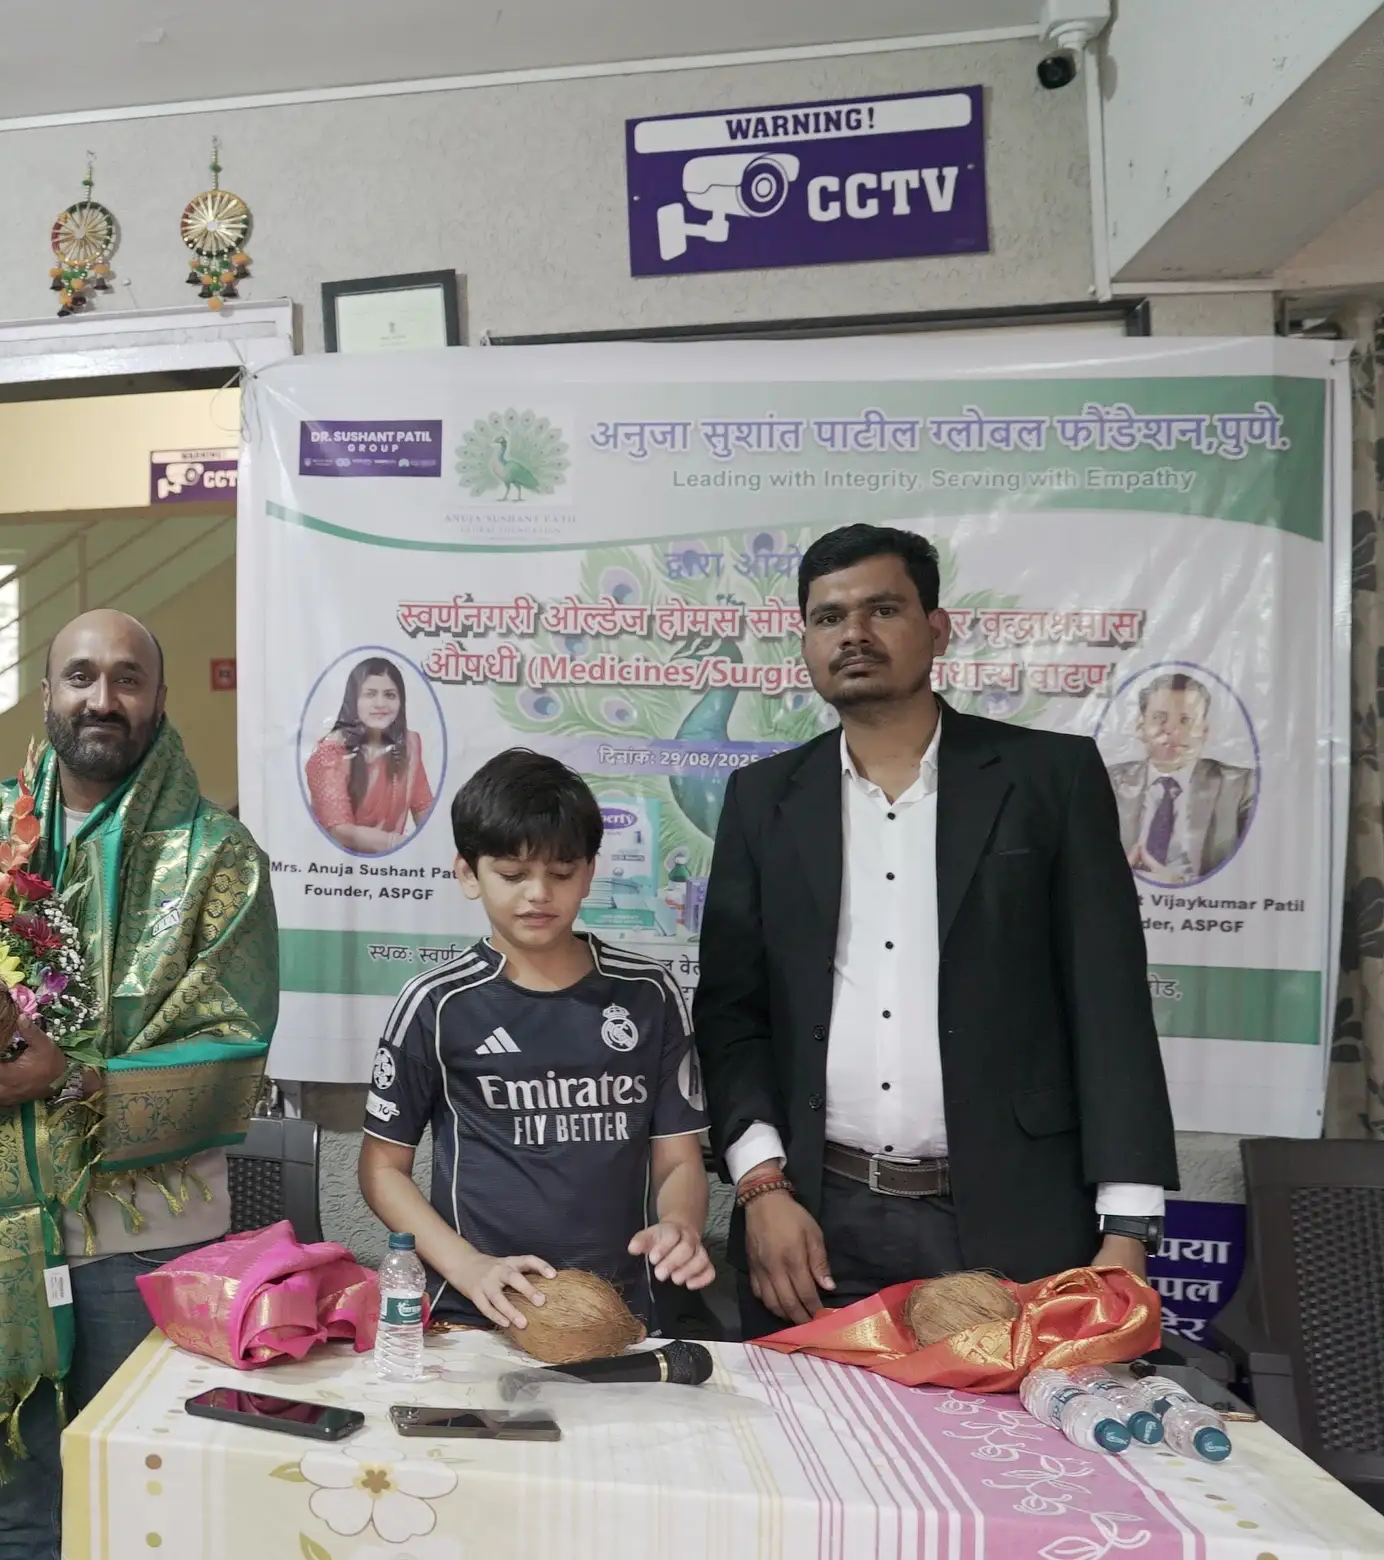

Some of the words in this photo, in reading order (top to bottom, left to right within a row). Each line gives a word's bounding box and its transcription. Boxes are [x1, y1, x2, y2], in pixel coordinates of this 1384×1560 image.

[725, 106, 875, 141] WARNING!
[807, 166, 958, 222] CCTV
[311, 431, 331, 442] DR.
[334, 431, 394, 442] SUSHANT
[396, 431, 432, 442] PATIL
[590, 420, 692, 458] अनुजा
[701, 413, 804, 458] सुशांत
[813, 409, 920, 449] पाटील
[930, 408, 1046, 449] ग्लोबल
[347, 443, 399, 453] GROUP
[203, 469, 238, 488] CCT
[672, 470, 761, 491] Leading
[769, 470, 816, 487] with
[931, 470, 1020, 491] Serving
[1028, 470, 1077, 487] with
[1087, 470, 1195, 491] Empathy
[399, 595, 536, 634] स्वर्णनगरी
[542, 597, 646, 634] ओल्डेज
[656, 597, 739, 634] होमस
[748, 597, 803, 634] सोश
[425, 641, 517, 681] औषधी
[528, 655, 810, 692] (Medicines/Surgic
[598, 745, 655, 765] दिनांक:
[271, 861, 301, 873] Mrs.
[307, 862, 353, 877] Anuja
[359, 864, 425, 878] Sushant
[431, 867, 458, 879] Pat
[304, 884, 372, 900] Founder,
[378, 887, 434, 900] ASPGF
[1151, 894, 1257, 911] Vijaykumar
[1263, 898, 1305, 912] Patil
[1141, 918, 1174, 933] der,
[1181, 919, 1244, 933] ASPGF
[418, 943, 463, 963] स्वर्ण
[477, 1070, 648, 1111] Emirates
[514, 1113, 549, 1145] FLY
[556, 1111, 630, 1143] BETTER
[1156, 1237, 1233, 1264] पया
[1147, 1276, 1223, 1303] पल
[1161, 1306, 1207, 1341] हेर
